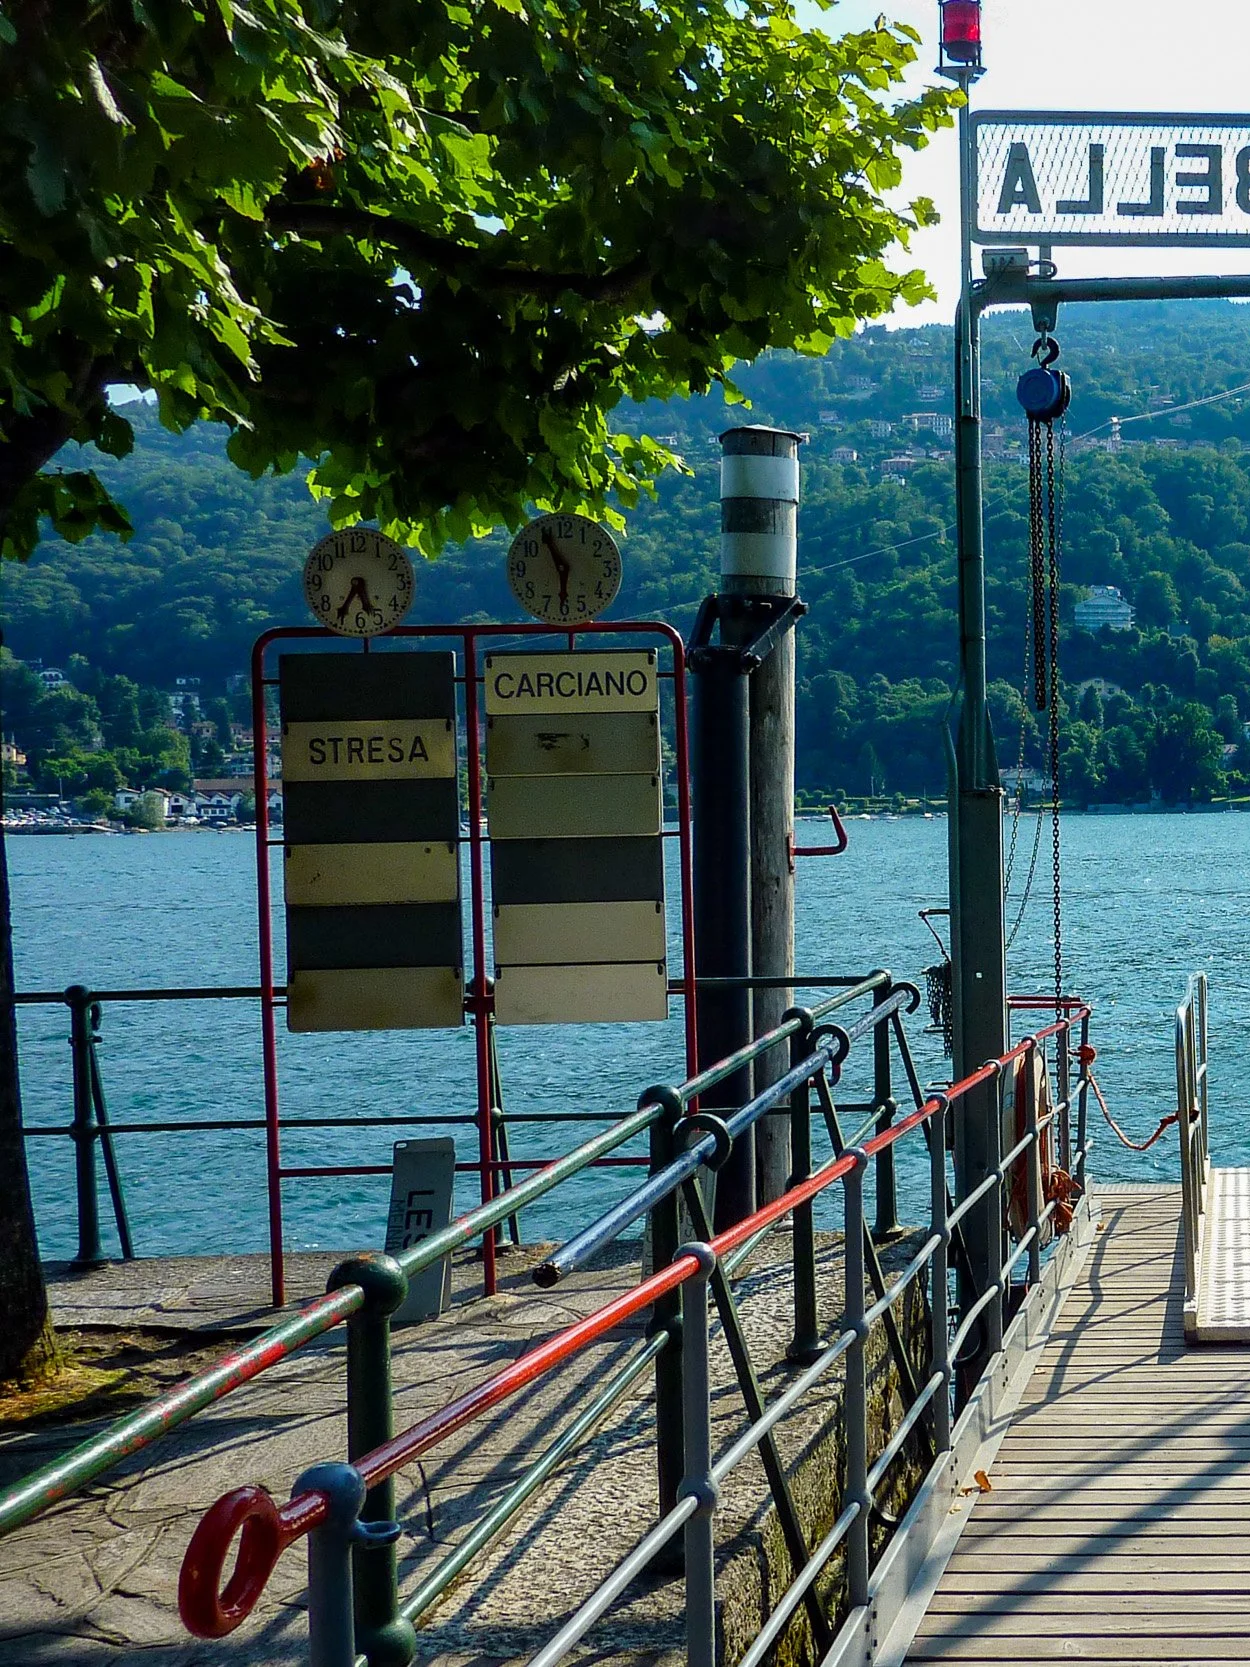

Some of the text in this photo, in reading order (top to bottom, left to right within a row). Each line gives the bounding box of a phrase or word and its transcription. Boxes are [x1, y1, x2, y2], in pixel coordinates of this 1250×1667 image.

[557, 520, 573, 539] 12
[580, 526, 586, 544] 1
[335, 541, 346, 559] 11
[350, 535, 366, 553] 12
[375, 541, 381, 558] 1
[523, 540, 539, 558] 10
[593, 540, 602, 558] 2
[317, 553, 333, 571] 10
[388, 553, 398, 571] 2
[516, 560, 526, 578] 9
[603, 560, 612, 578] 3
[312, 574, 322, 591] 9
[396, 573, 406, 591] 3
[525, 581, 535, 599] 8
[594, 580, 603, 599] 4
[321, 594, 331, 612] 8
[388, 594, 399, 612] 4
[542, 594, 552, 613] 7
[576, 594, 586, 613] 5
[355, 611, 366, 629] 6
[372, 608, 383, 626] 5
[494, 669, 648, 699] CARCIANO
[308, 735, 429, 765] STRESA
